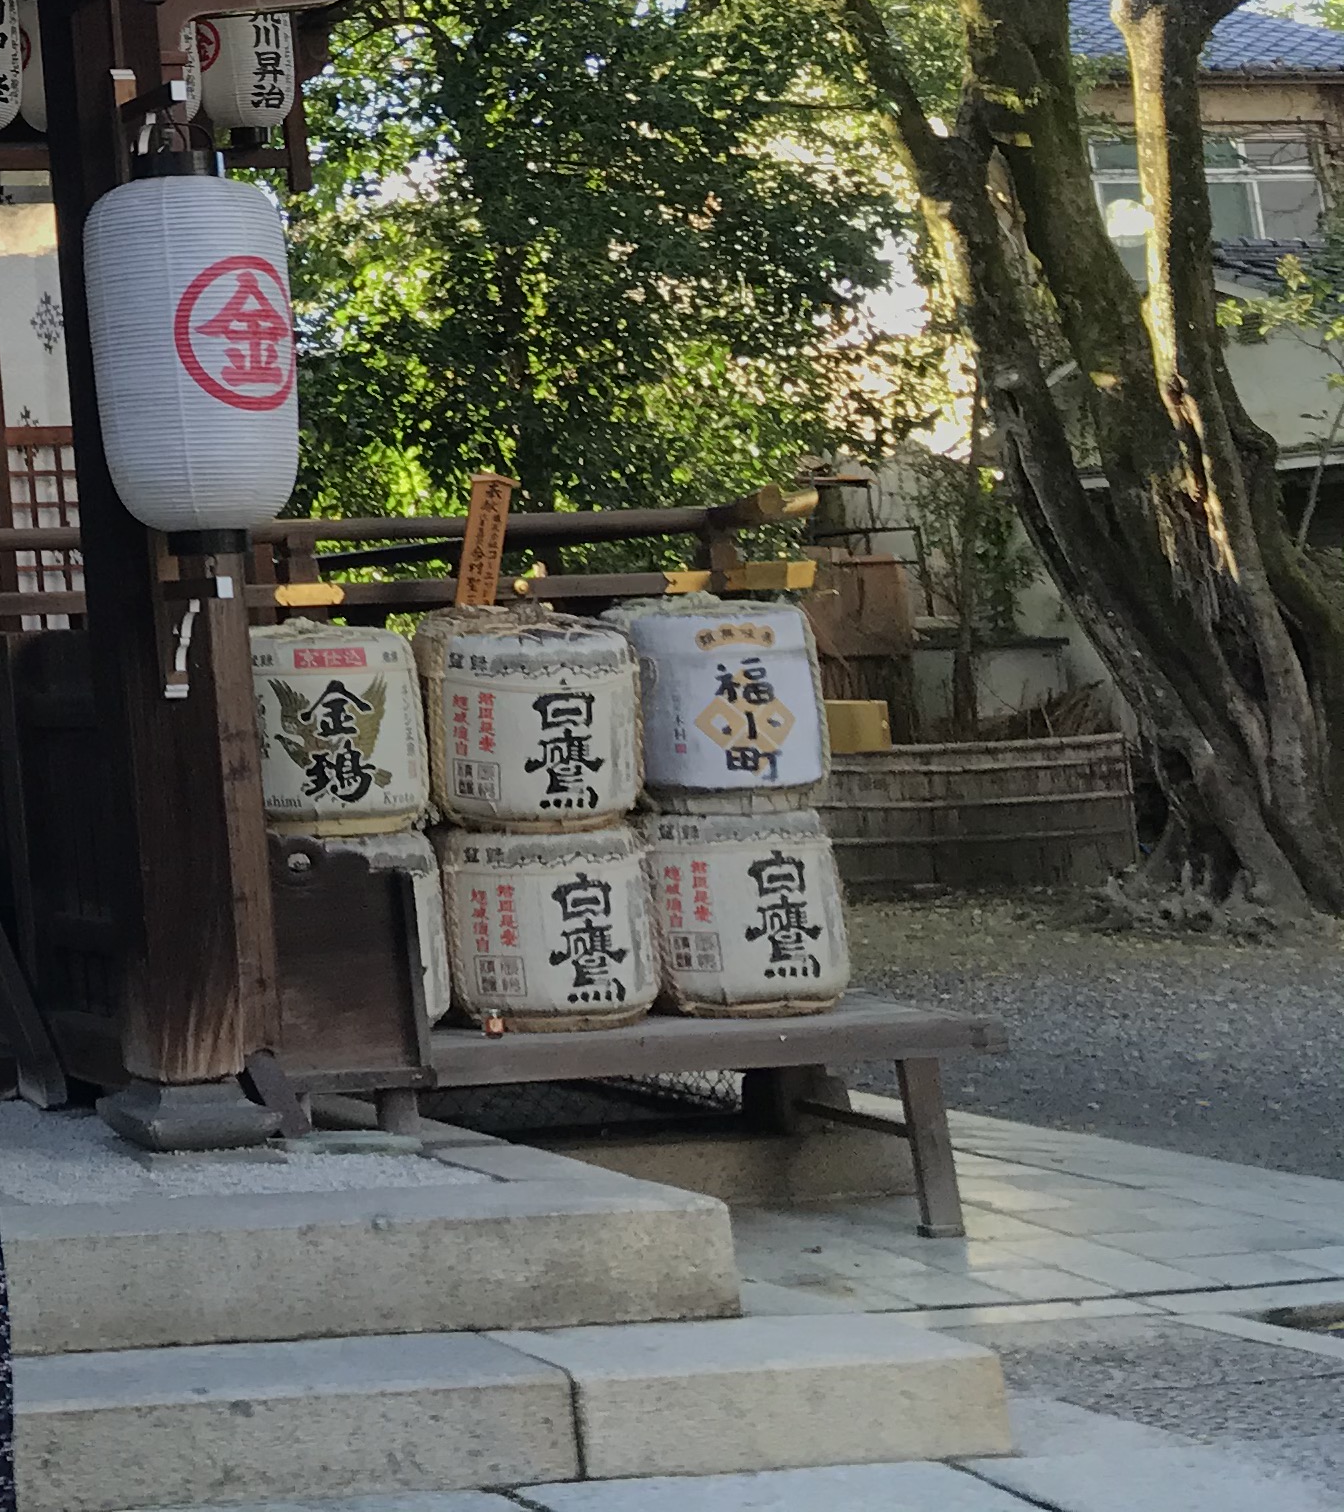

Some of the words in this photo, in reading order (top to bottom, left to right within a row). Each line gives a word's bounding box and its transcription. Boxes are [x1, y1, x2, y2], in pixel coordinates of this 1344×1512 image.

[194, 270, 289, 388] 金
[298, 648, 362, 667] 京仕込
[714, 657, 783, 782] 福小町
[383, 790, 415, 805] Kyoto
[524, 678, 605, 809] 白鷹
[549, 872, 628, 1004] 白鷹
[745, 849, 823, 979] 白鷹
